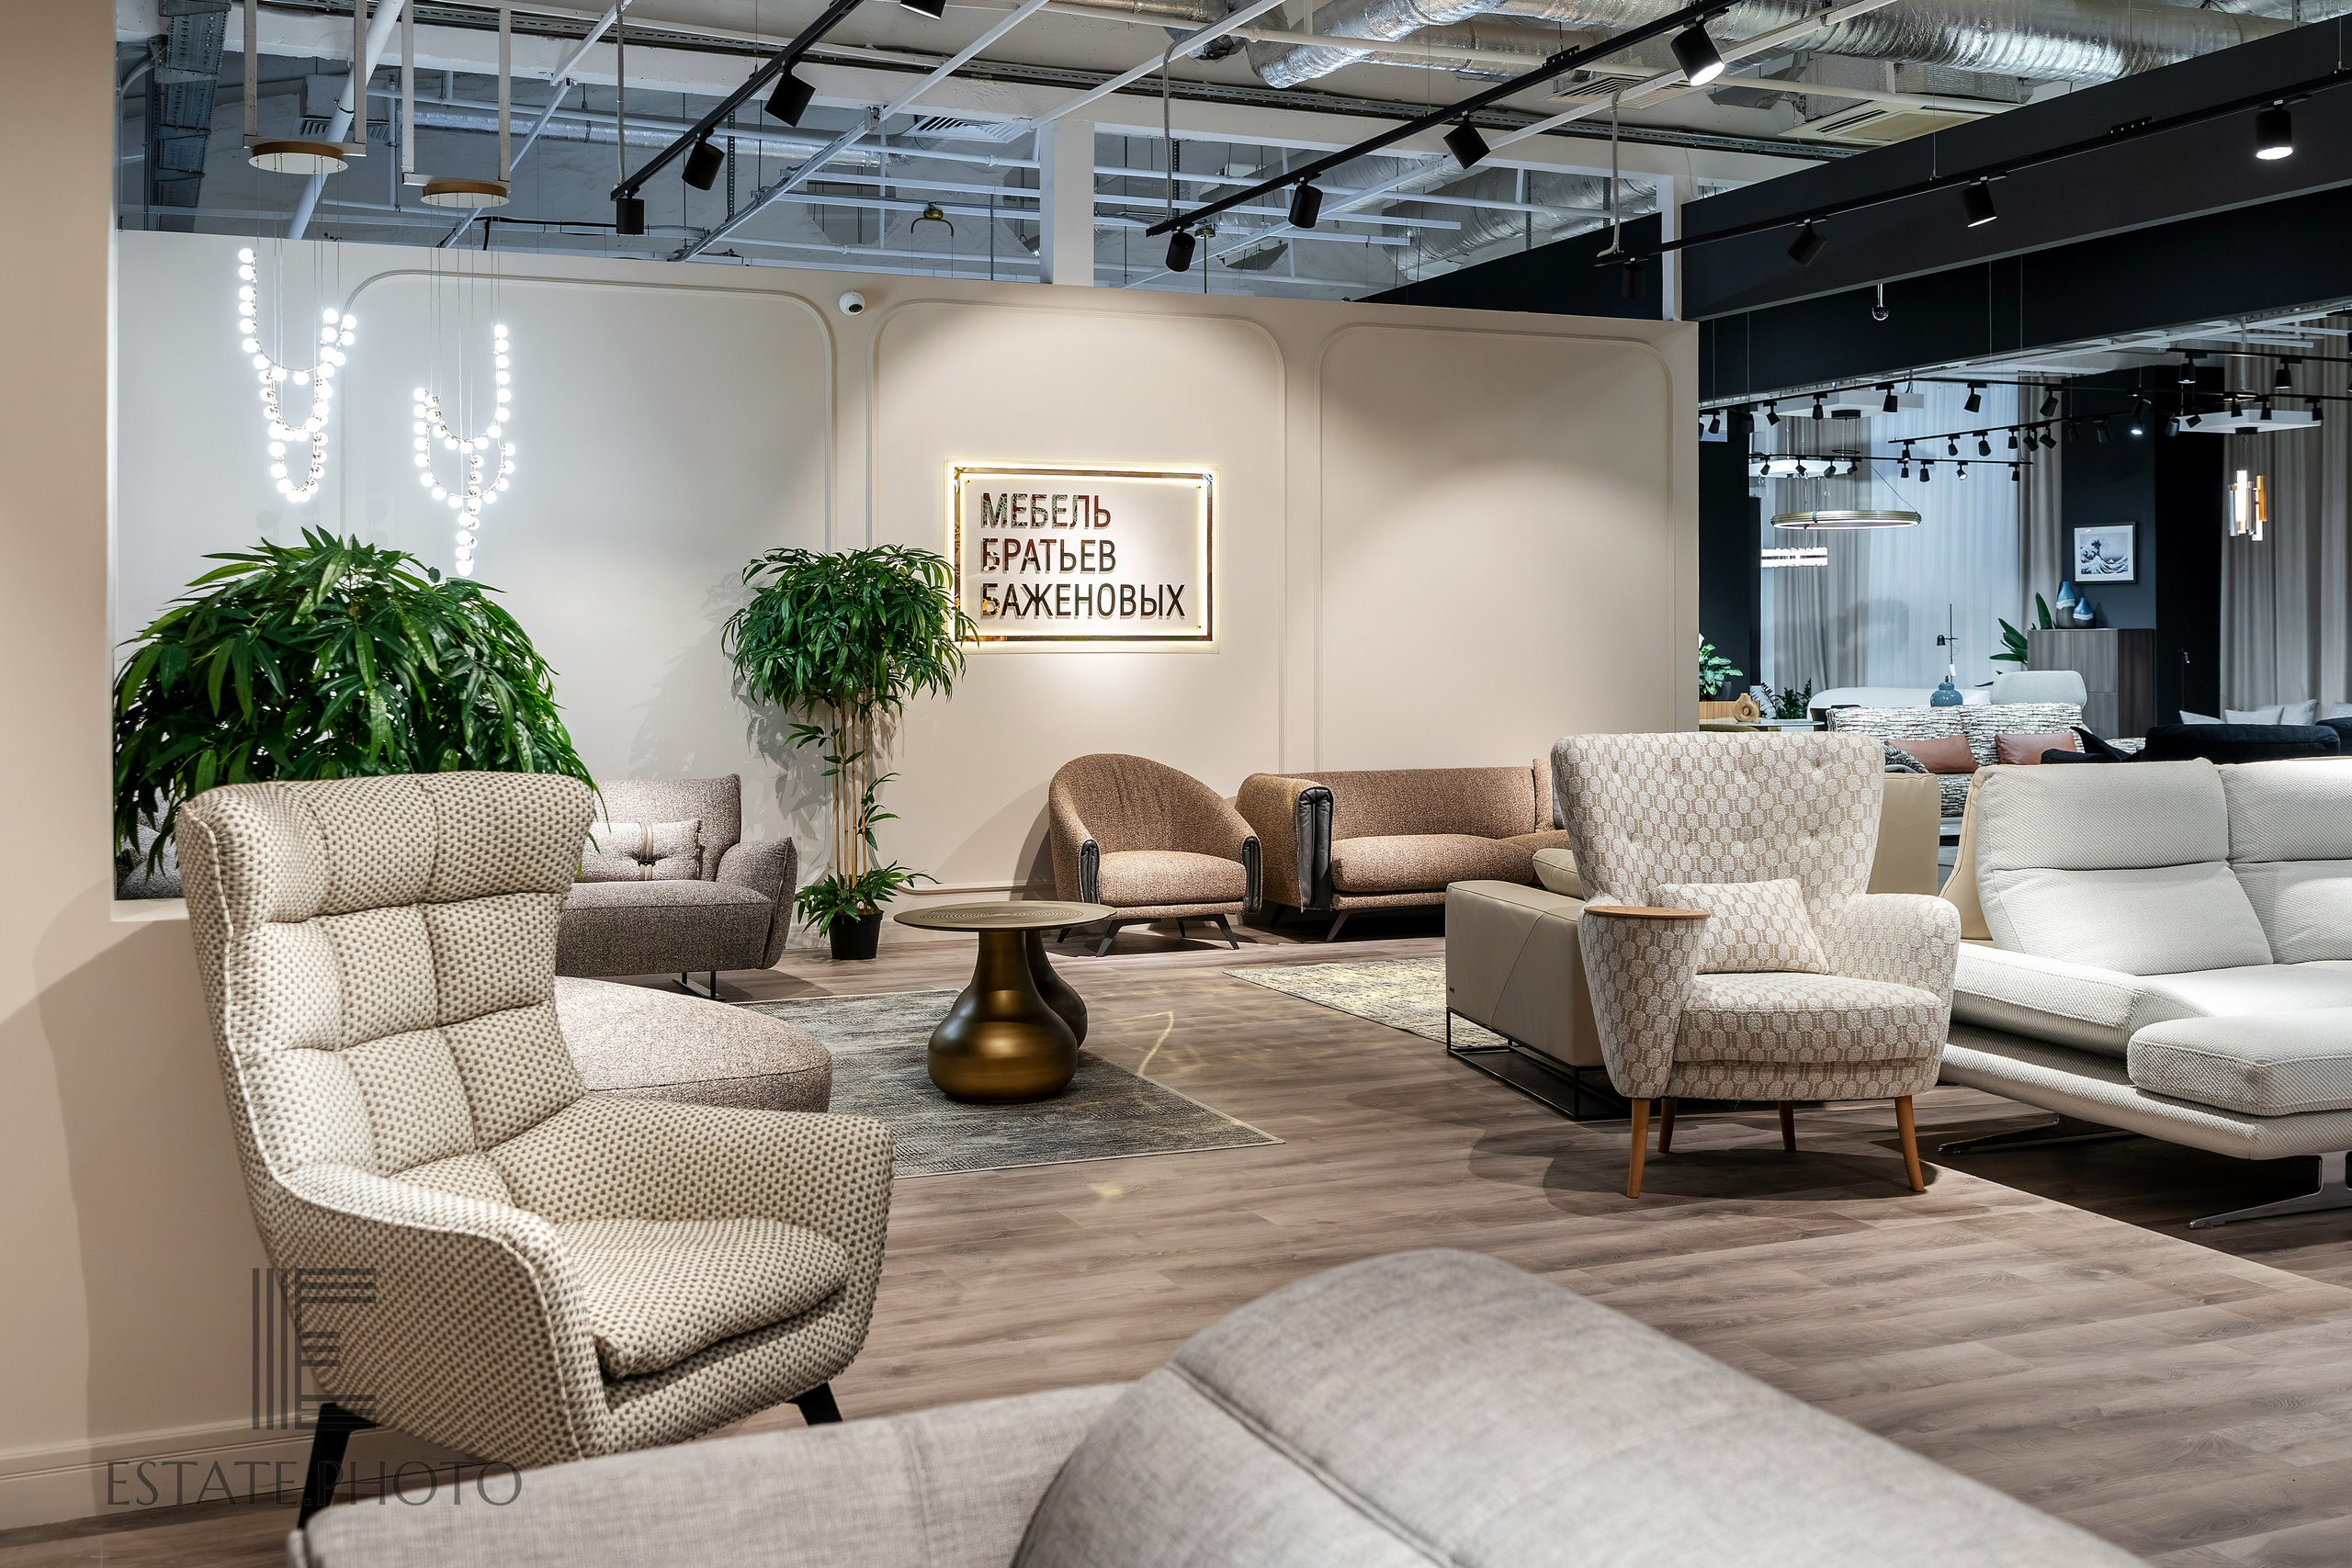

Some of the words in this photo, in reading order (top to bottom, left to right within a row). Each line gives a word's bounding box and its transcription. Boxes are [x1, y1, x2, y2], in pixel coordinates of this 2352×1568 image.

[981, 492, 1112, 529] МЕБЕЛЬ
[981, 537, 1116, 573] БРАТЬЕВ
[981, 582, 1186, 618] БАЖЕНОВЫХ
